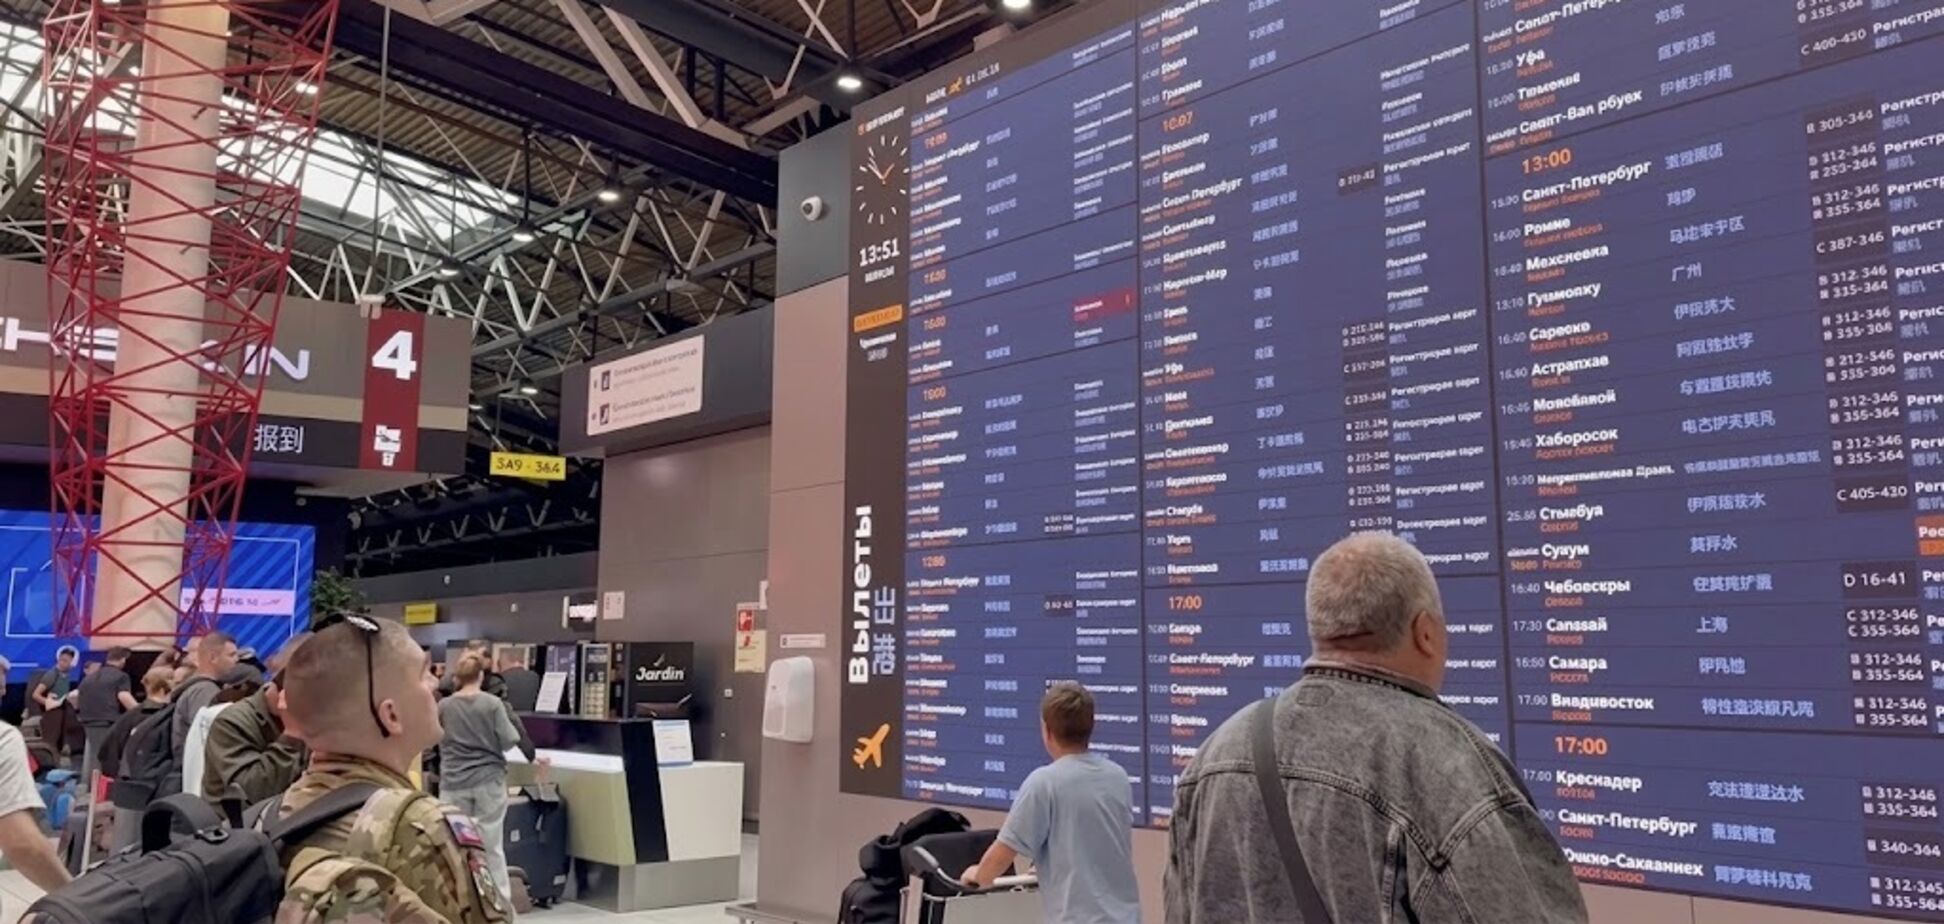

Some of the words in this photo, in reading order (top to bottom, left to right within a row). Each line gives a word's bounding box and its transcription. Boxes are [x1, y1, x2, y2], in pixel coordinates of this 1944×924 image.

[1516, 49, 1546, 67] Уфа
[1522, 148, 1572, 174] 13:00
[1824, 184, 1880, 205] 312-346
[859, 238, 900, 267] 13:51
[1672, 262, 1702, 282] 广州
[371, 330, 417, 380] 4
[253, 424, 305, 454] 报到
[1836, 489, 1847, 501] C
[1843, 573, 1856, 587] D
[1861, 571, 1906, 587] 16-41
[848, 505, 872, 684] Вылеты
[1846, 610, 1857, 622] C
[1860, 608, 1919, 622] 312-346
[1549, 655, 1608, 673] Самара
[1864, 653, 1922, 666] 312-346
[635, 666, 685, 682] Jardin
[1555, 736, 1608, 755] 17:00
[1558, 808, 1698, 836] Санкт-Петербург
